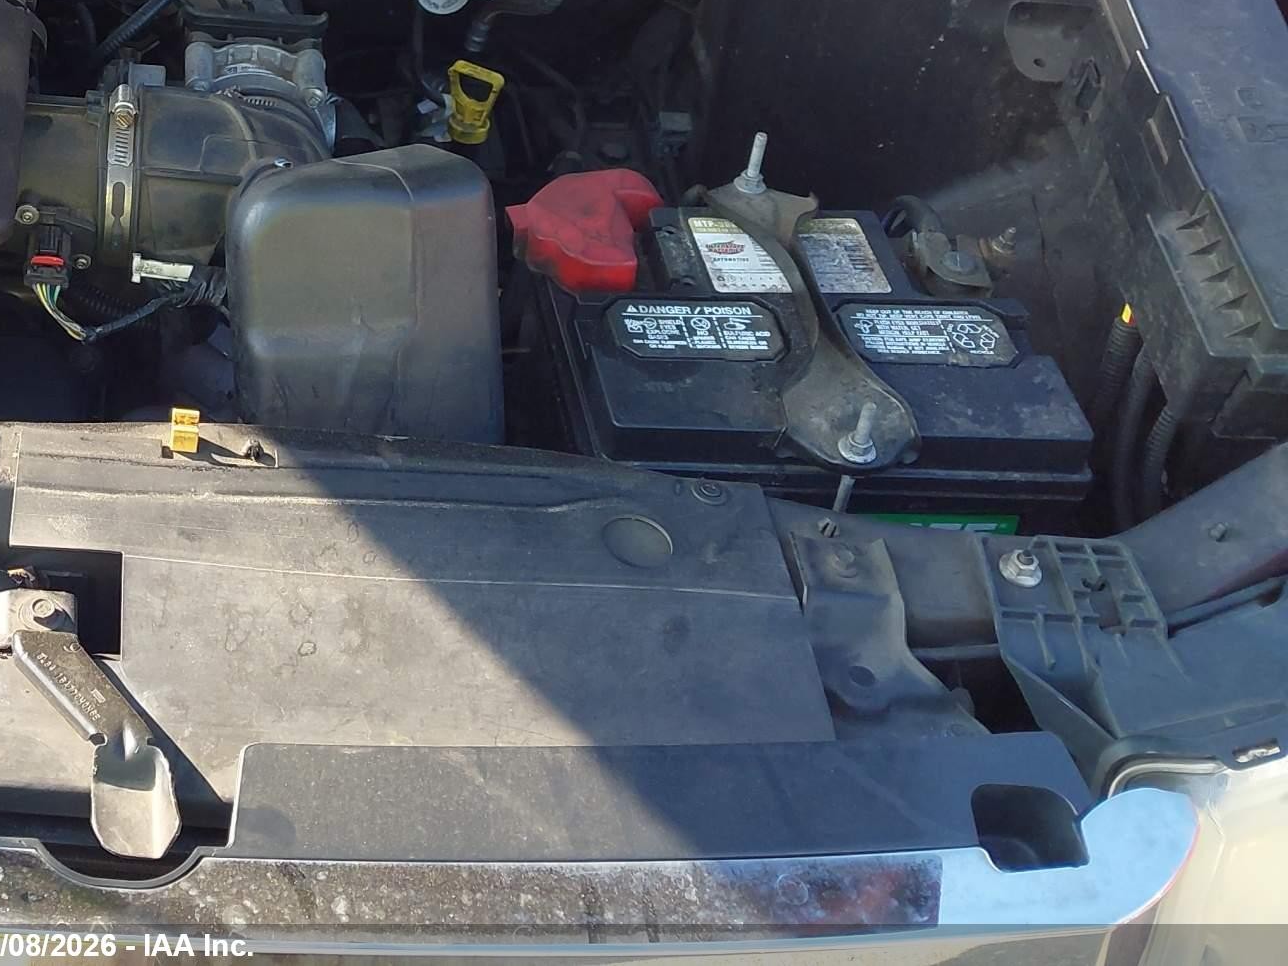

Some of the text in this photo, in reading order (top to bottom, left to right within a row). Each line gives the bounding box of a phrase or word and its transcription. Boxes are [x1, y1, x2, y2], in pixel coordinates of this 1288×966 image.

[638, 305, 752, 315] DANGER / POISON
